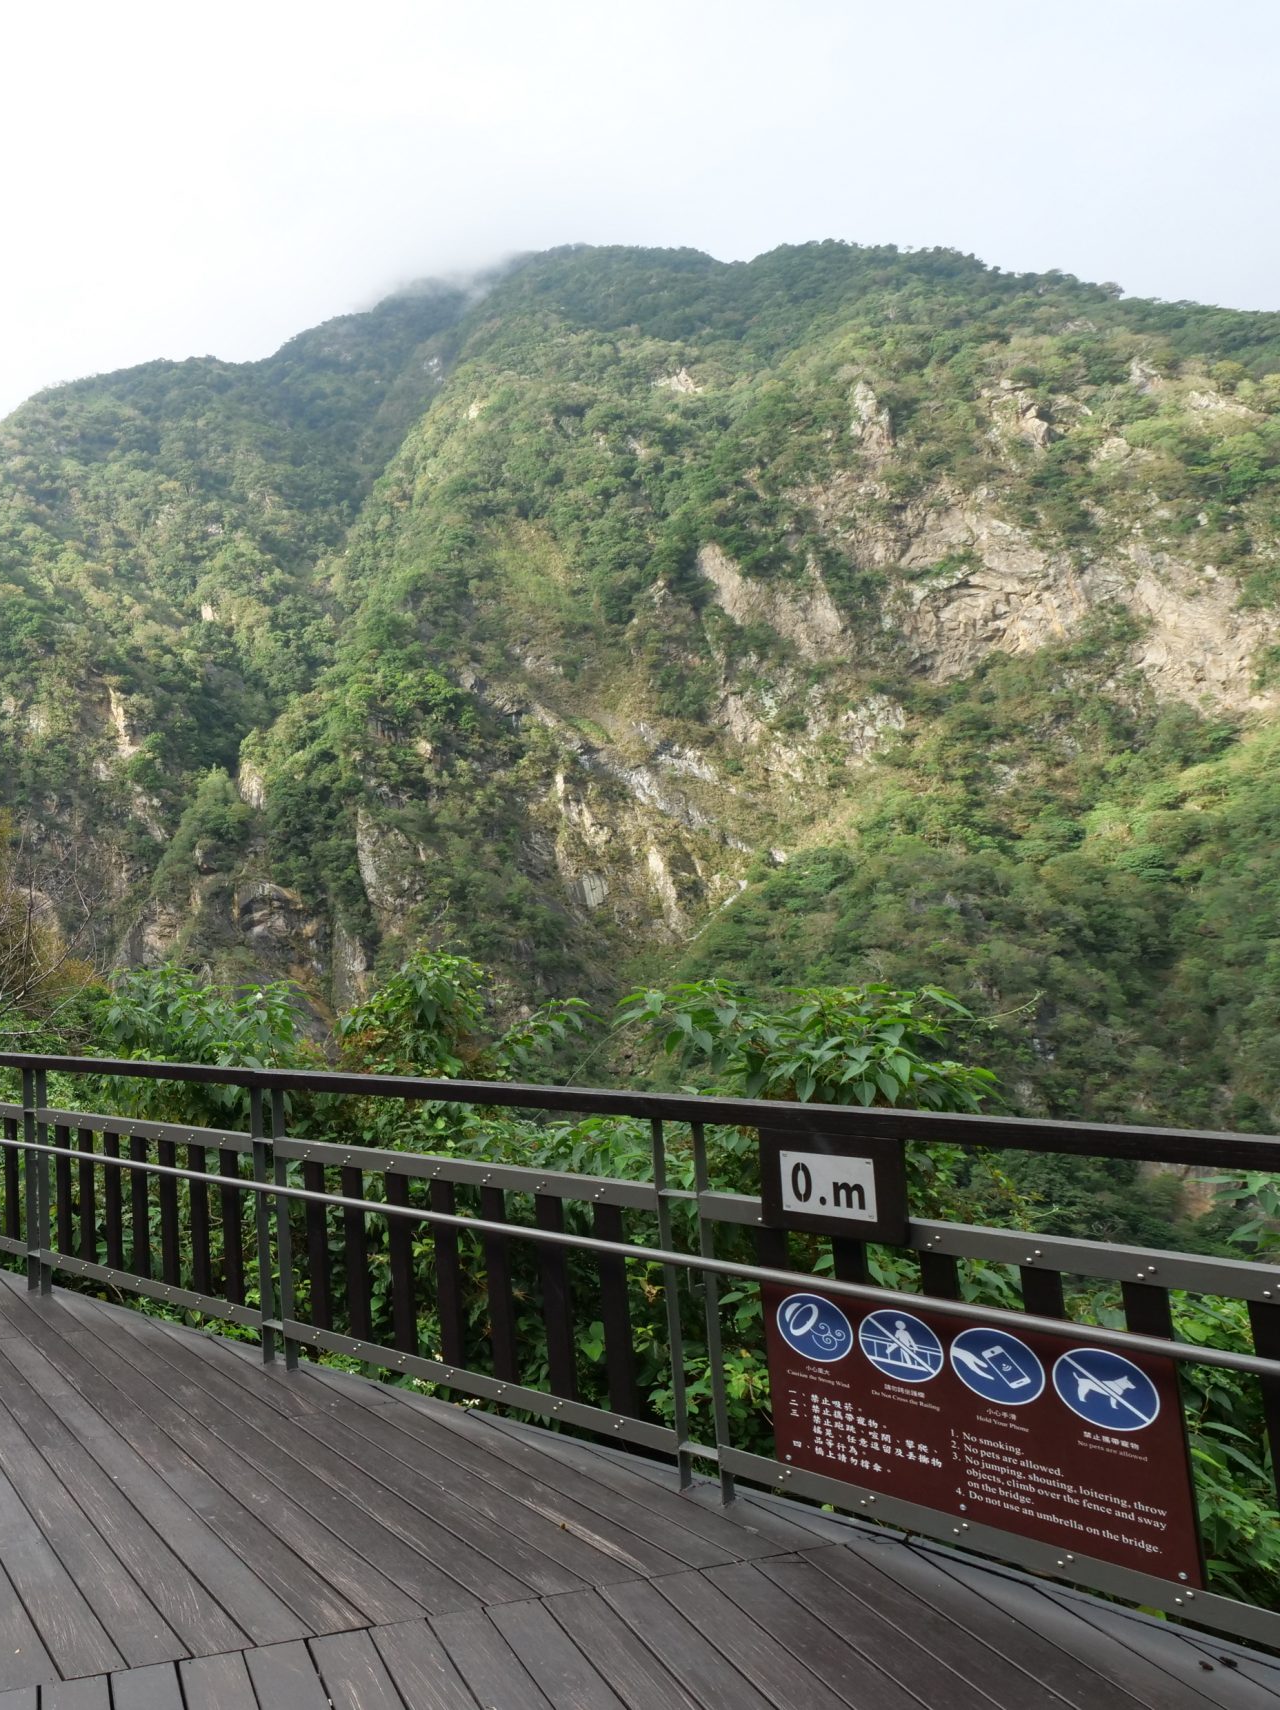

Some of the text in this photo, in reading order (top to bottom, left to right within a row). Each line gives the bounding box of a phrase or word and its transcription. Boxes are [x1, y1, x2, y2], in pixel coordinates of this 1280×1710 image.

[787, 1369, 808, 1379] Caution
[835, 1380, 850, 1389] Wind
[880, 1391, 891, 1399] Not
[892, 1394, 909, 1403] Cross
[919, 1401, 940, 1412] Railing
[976, 1414, 1030, 1433] Hold Your Phone
[950, 1428, 1025, 1456] 1. No smoking.
[1088, 1443, 1105, 1452] pets
[1105, 1447, 1118, 1455] are
[1118, 1450, 1148, 1462] allowed
[950, 1440, 1065, 1477] 2. No pets are allowed.
[952, 1452, 961, 1461] 3.
[964, 1454, 980, 1466] No
[1133, 1500, 1168, 1517] throw
[967, 1480, 1035, 1505] on the bridge.
[1006, 1479, 1036, 1494] climb
[1037, 1487, 1061, 1500] over
[1063, 1493, 1080, 1506] the
[1082, 1499, 1113, 1515] fence
[1114, 1508, 1136, 1521] and
[1137, 1515, 1167, 1531] sway
[955, 1486, 1163, 1555] 4. Do not use an umbrella on the bridge.
